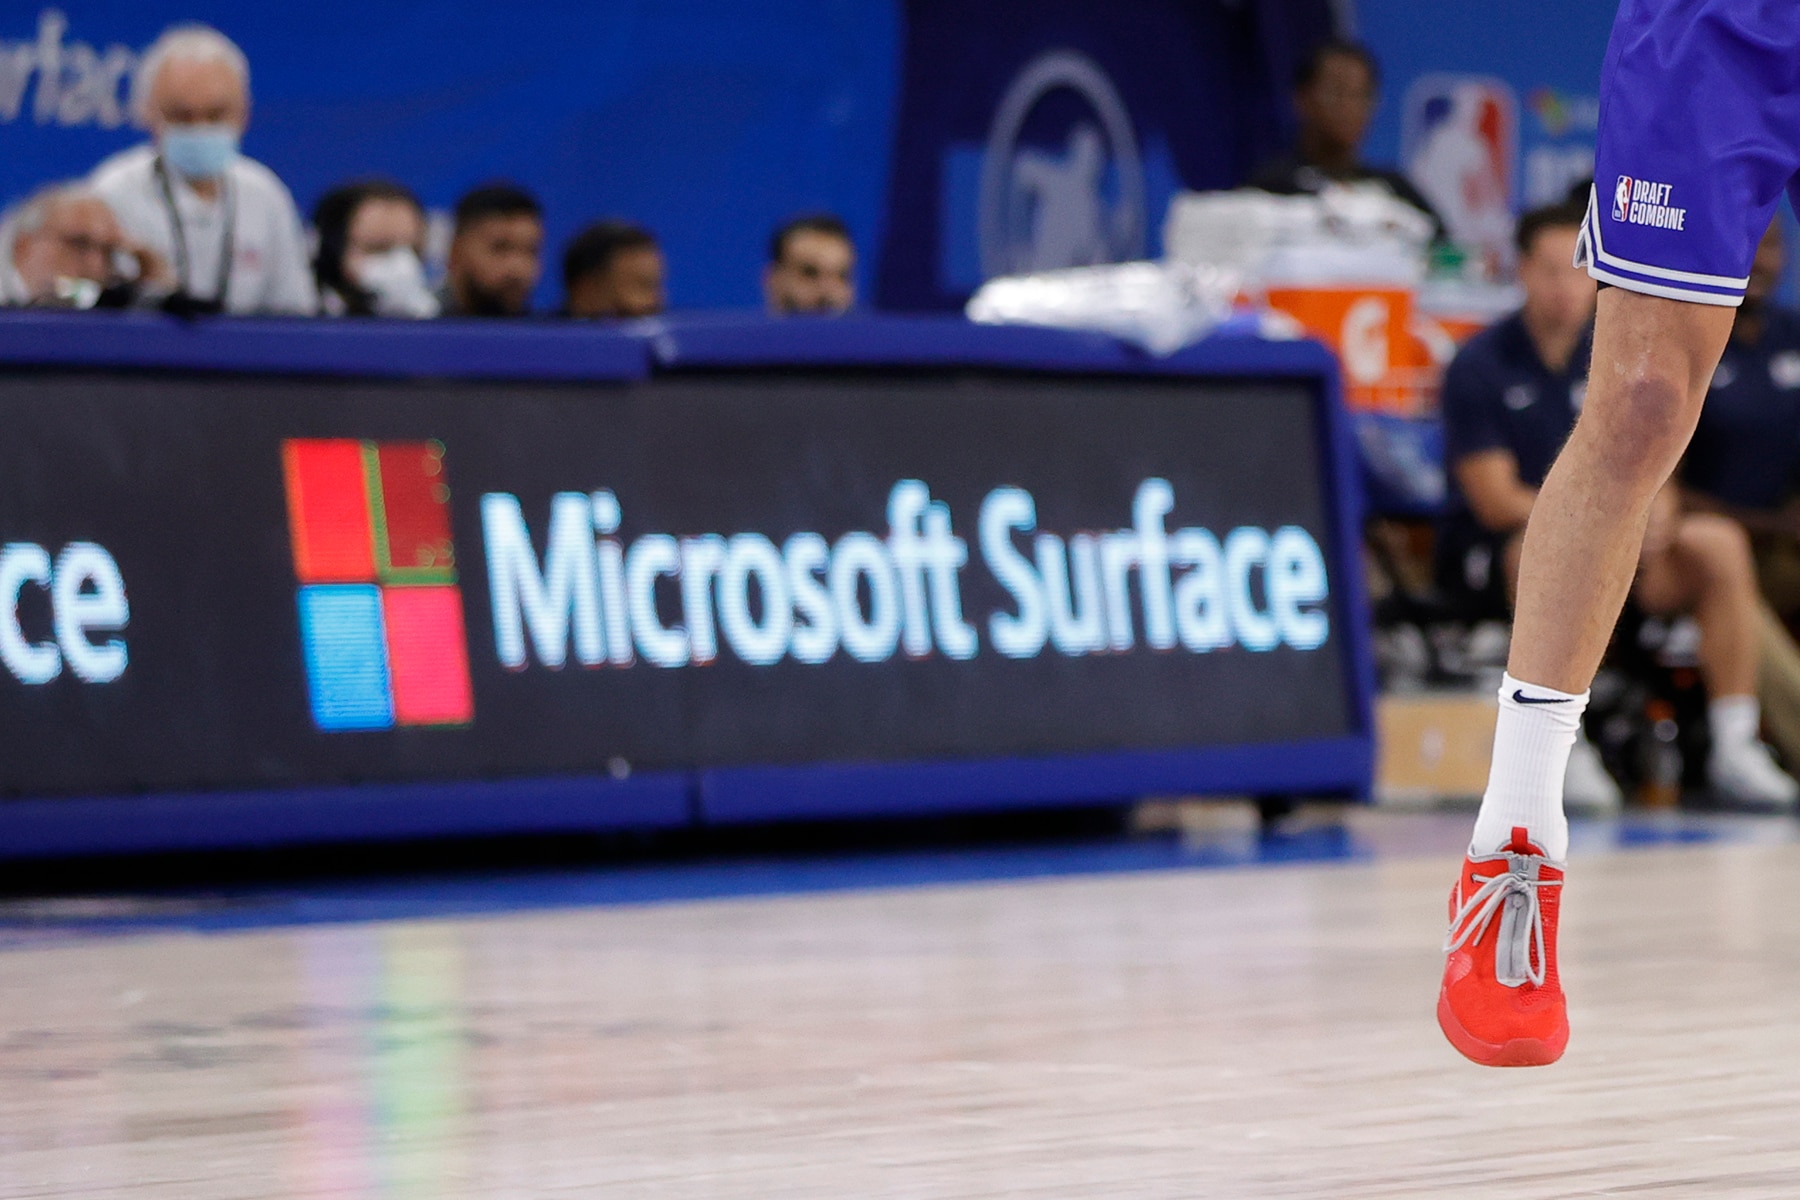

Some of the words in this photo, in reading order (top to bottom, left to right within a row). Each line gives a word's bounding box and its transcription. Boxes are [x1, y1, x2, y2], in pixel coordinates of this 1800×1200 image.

[1632, 179, 1673, 206] DRAFT
[1629, 202, 1687, 231] COMBINE
[481, 479, 979, 670] Microsoft
[980, 477, 1329, 659] Surface
